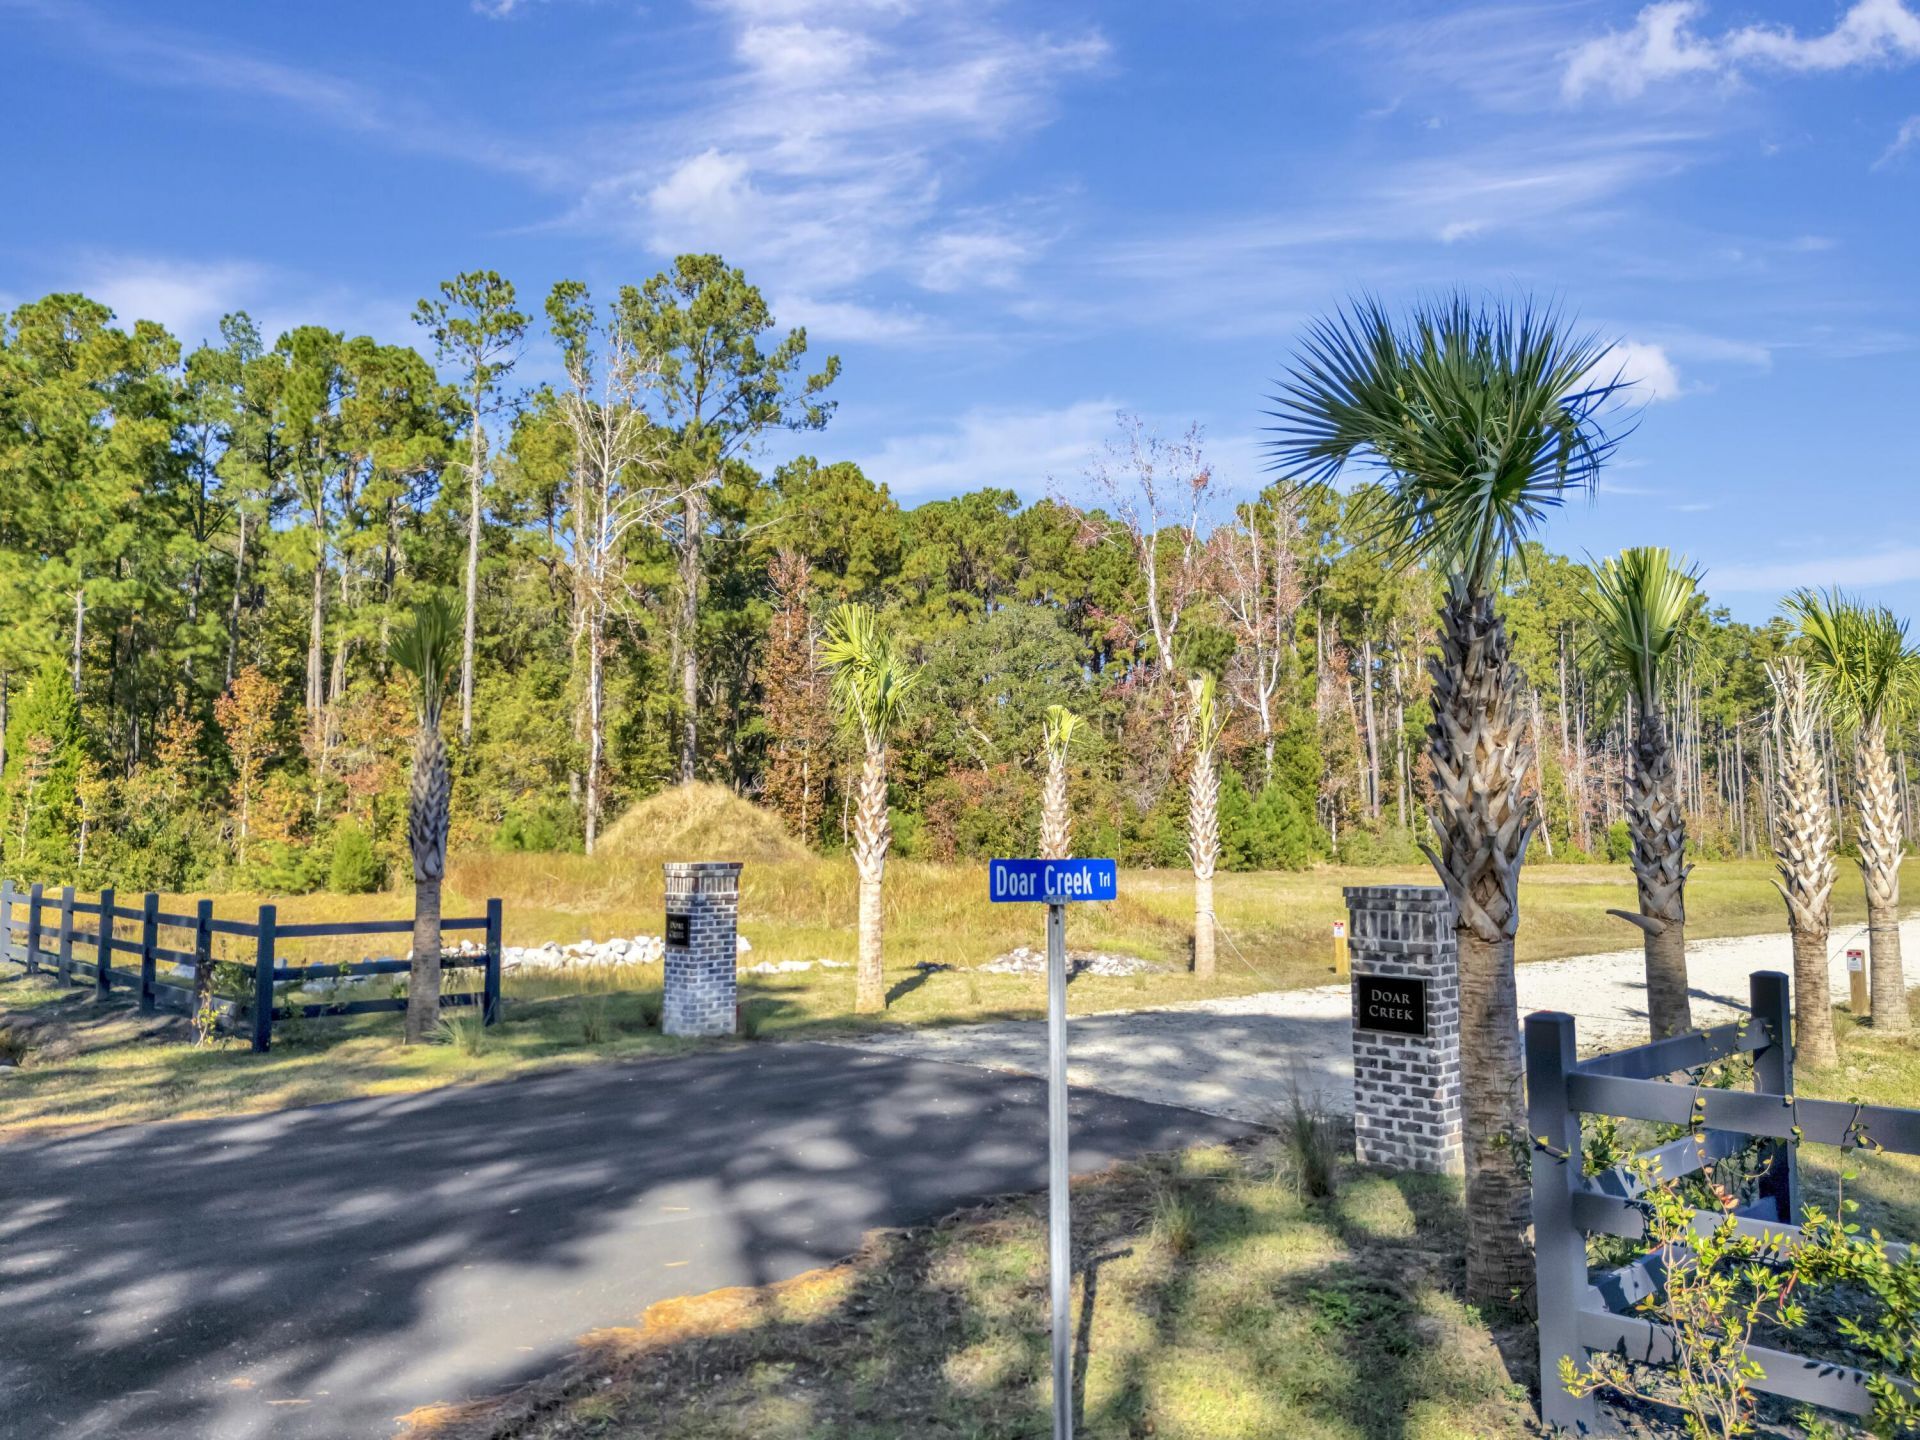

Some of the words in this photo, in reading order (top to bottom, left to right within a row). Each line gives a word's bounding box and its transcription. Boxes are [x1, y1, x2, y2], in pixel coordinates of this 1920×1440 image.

[996, 865, 1037, 896] Doar
[1044, 865, 1093, 895] Creek
[1098, 871, 1111, 887] Trl
[1371, 989, 1411, 1005] DOAR
[1368, 1004, 1414, 1021] CREEK
